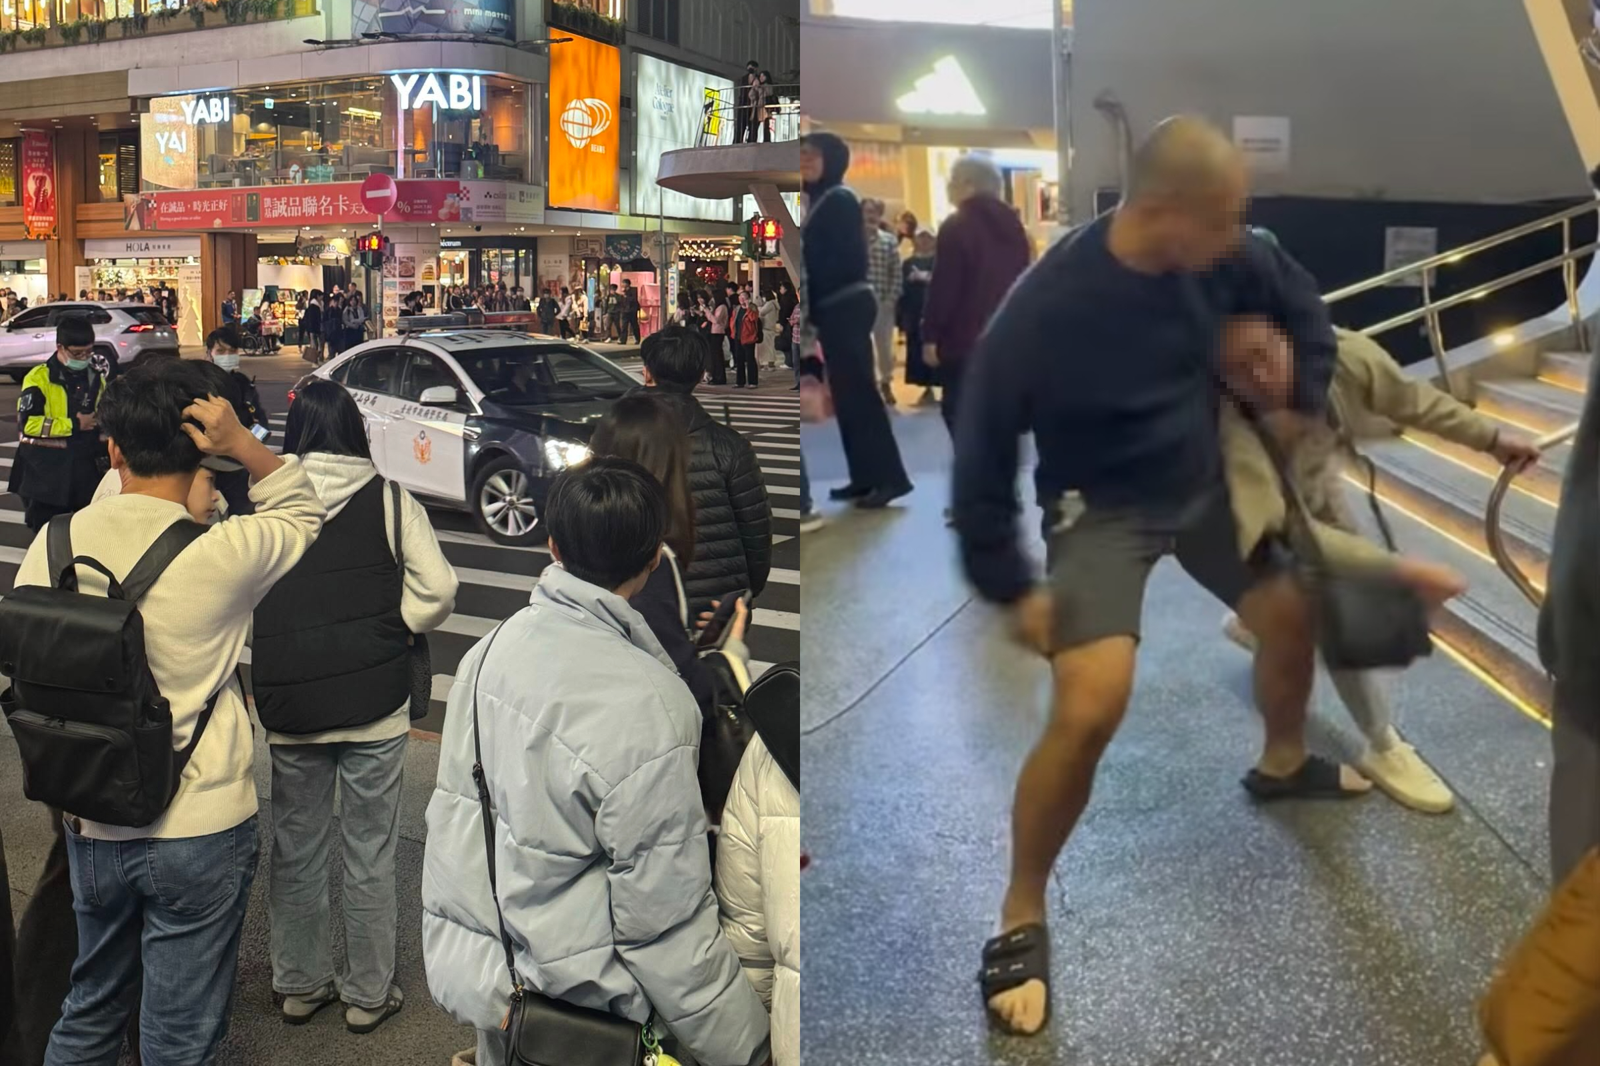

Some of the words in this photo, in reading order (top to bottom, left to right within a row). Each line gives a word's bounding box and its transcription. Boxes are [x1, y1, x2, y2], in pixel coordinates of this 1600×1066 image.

[463, 7, 482, 16] mini
[389, 72, 481, 111] YABI
[180, 97, 230, 124] YABI
[126, 242, 150, 252] HOLA
